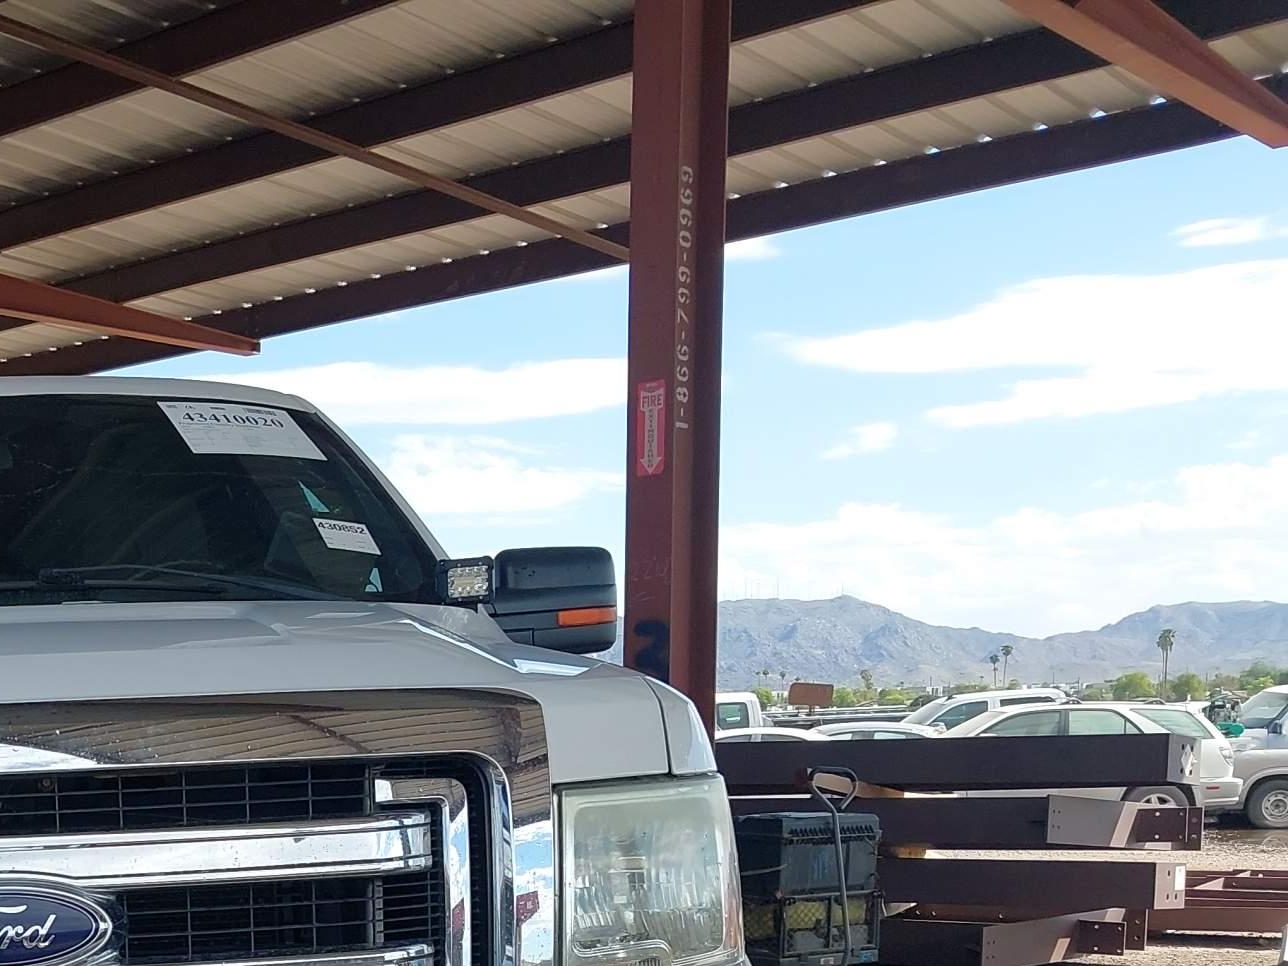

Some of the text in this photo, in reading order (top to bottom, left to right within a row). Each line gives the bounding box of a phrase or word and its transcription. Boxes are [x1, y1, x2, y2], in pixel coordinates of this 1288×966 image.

[675, 165, 693, 429] 1-866-799-0969
[642, 393, 663, 409] FIRE
[182, 411, 285, 429] 43410020
[317, 521, 368, 535] 430852
